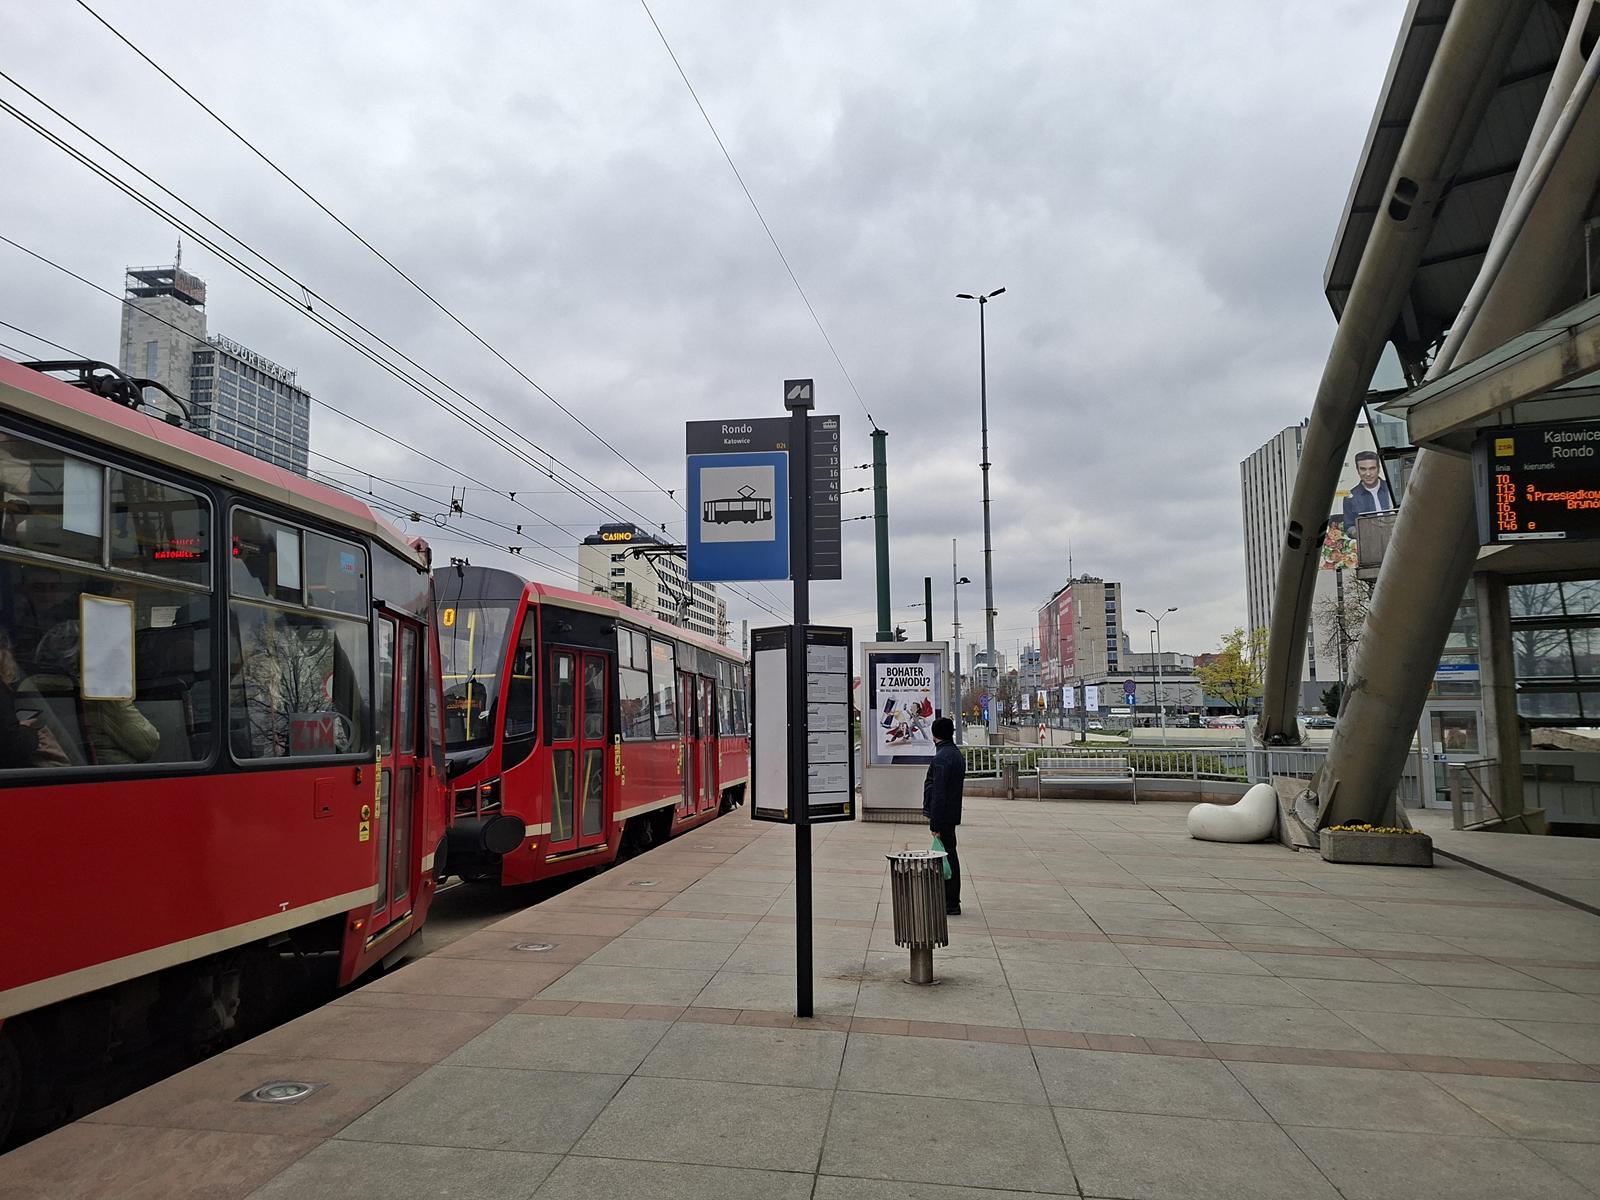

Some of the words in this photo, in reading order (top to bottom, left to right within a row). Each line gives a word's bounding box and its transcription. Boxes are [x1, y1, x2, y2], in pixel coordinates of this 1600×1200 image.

[721, 424, 753, 434] Rondo
[832, 433, 838, 441] 0
[1544, 430, 1600, 443] Katowice
[1552, 445, 1594, 458] Rondo
[830, 457, 838, 466] 13
[1495, 464, 1511, 472] linia
[830, 470, 838, 478] 16
[1495, 474, 1510, 484] T0
[830, 482, 838, 490] 41
[1496, 484, 1516, 493] T13
[828, 494, 838, 502] 46
[1496, 493, 1516, 502] T16
[1496, 502, 1511, 512] T6
[1567, 499, 1600, 510] Brynó
[1497, 511, 1517, 521] T13
[1497, 521, 1518, 531] T46
[602, 532, 632, 541] CASINO
[886, 666, 924, 677] BOHATER
[880, 677, 886, 687] Z
[888, 677, 931, 687] ZAWODU?
